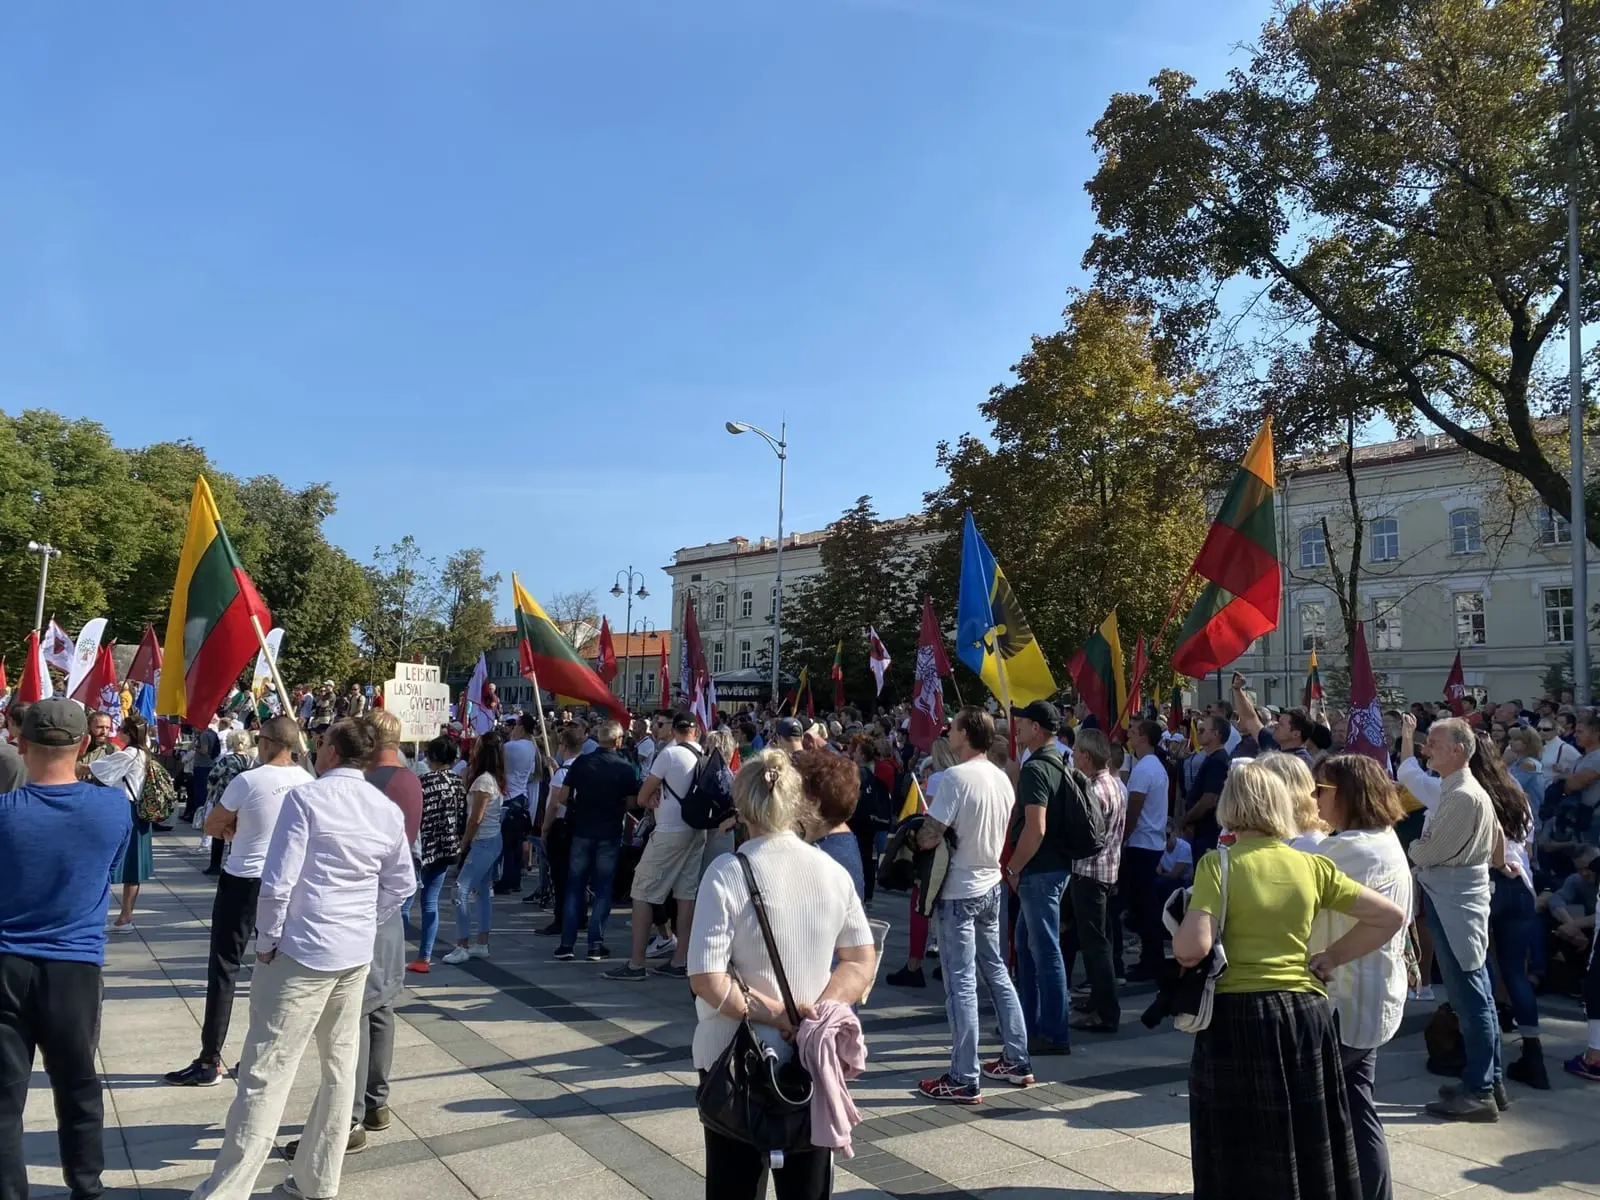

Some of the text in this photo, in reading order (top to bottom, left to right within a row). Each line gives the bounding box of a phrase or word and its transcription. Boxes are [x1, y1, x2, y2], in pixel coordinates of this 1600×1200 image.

[405, 666, 438, 683] LEISKIT
[394, 683, 422, 696] LAISVAI
[707, 686, 755, 696] ARVESEN
